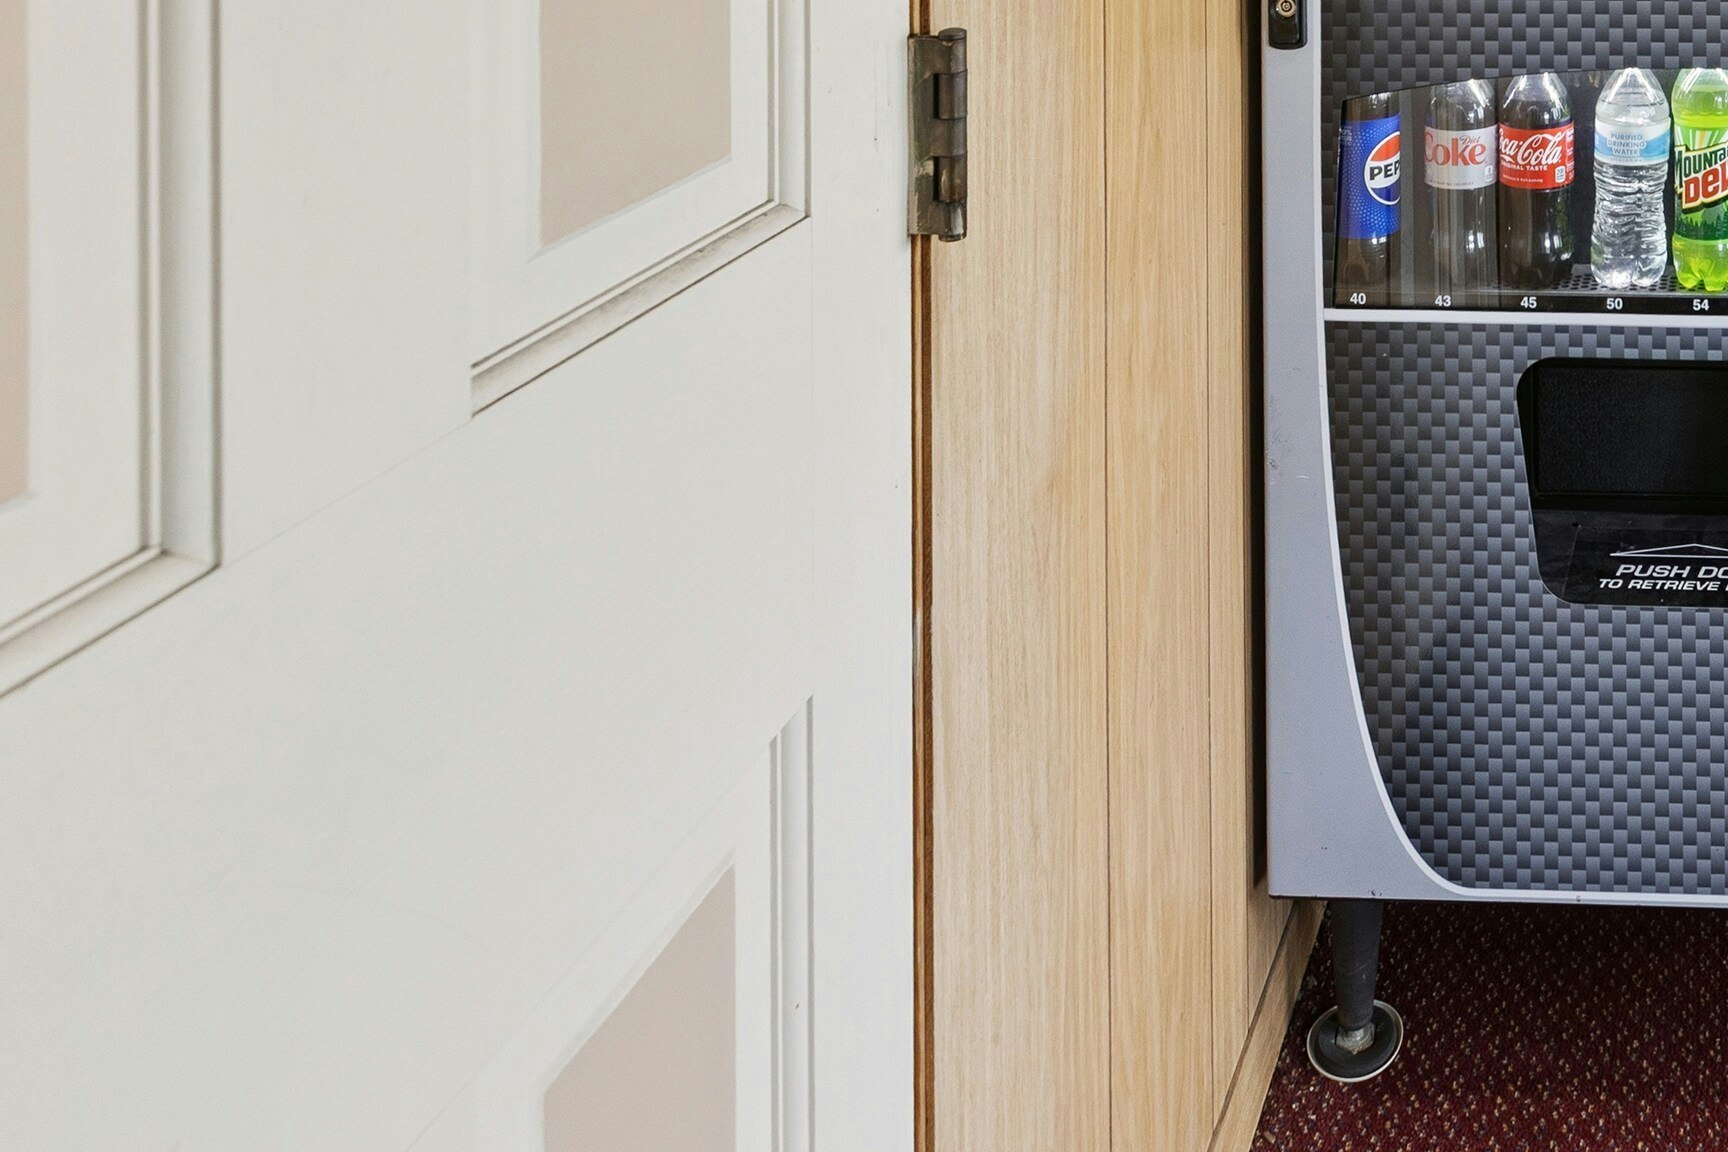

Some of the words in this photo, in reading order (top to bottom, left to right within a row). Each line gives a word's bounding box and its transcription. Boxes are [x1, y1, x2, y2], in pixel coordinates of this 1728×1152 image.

[1460, 135, 1481, 145] Diet
[1610, 132, 1643, 141] PURIFIED
[1425, 132, 1488, 166] Coke
[1607, 140, 1646, 149] DRINKING
[1613, 148, 1639, 156] WATER
[1350, 293, 1367, 306] 40
[1435, 296, 1452, 308] 43
[1520, 297, 1538, 310] 45
[1606, 298, 1624, 312] 50
[1693, 299, 1710, 312] 54
[1616, 564, 1691, 578] PUSH
[1599, 579, 1624, 589] TO
[1627, 580, 1722, 592] RETRIEVE
